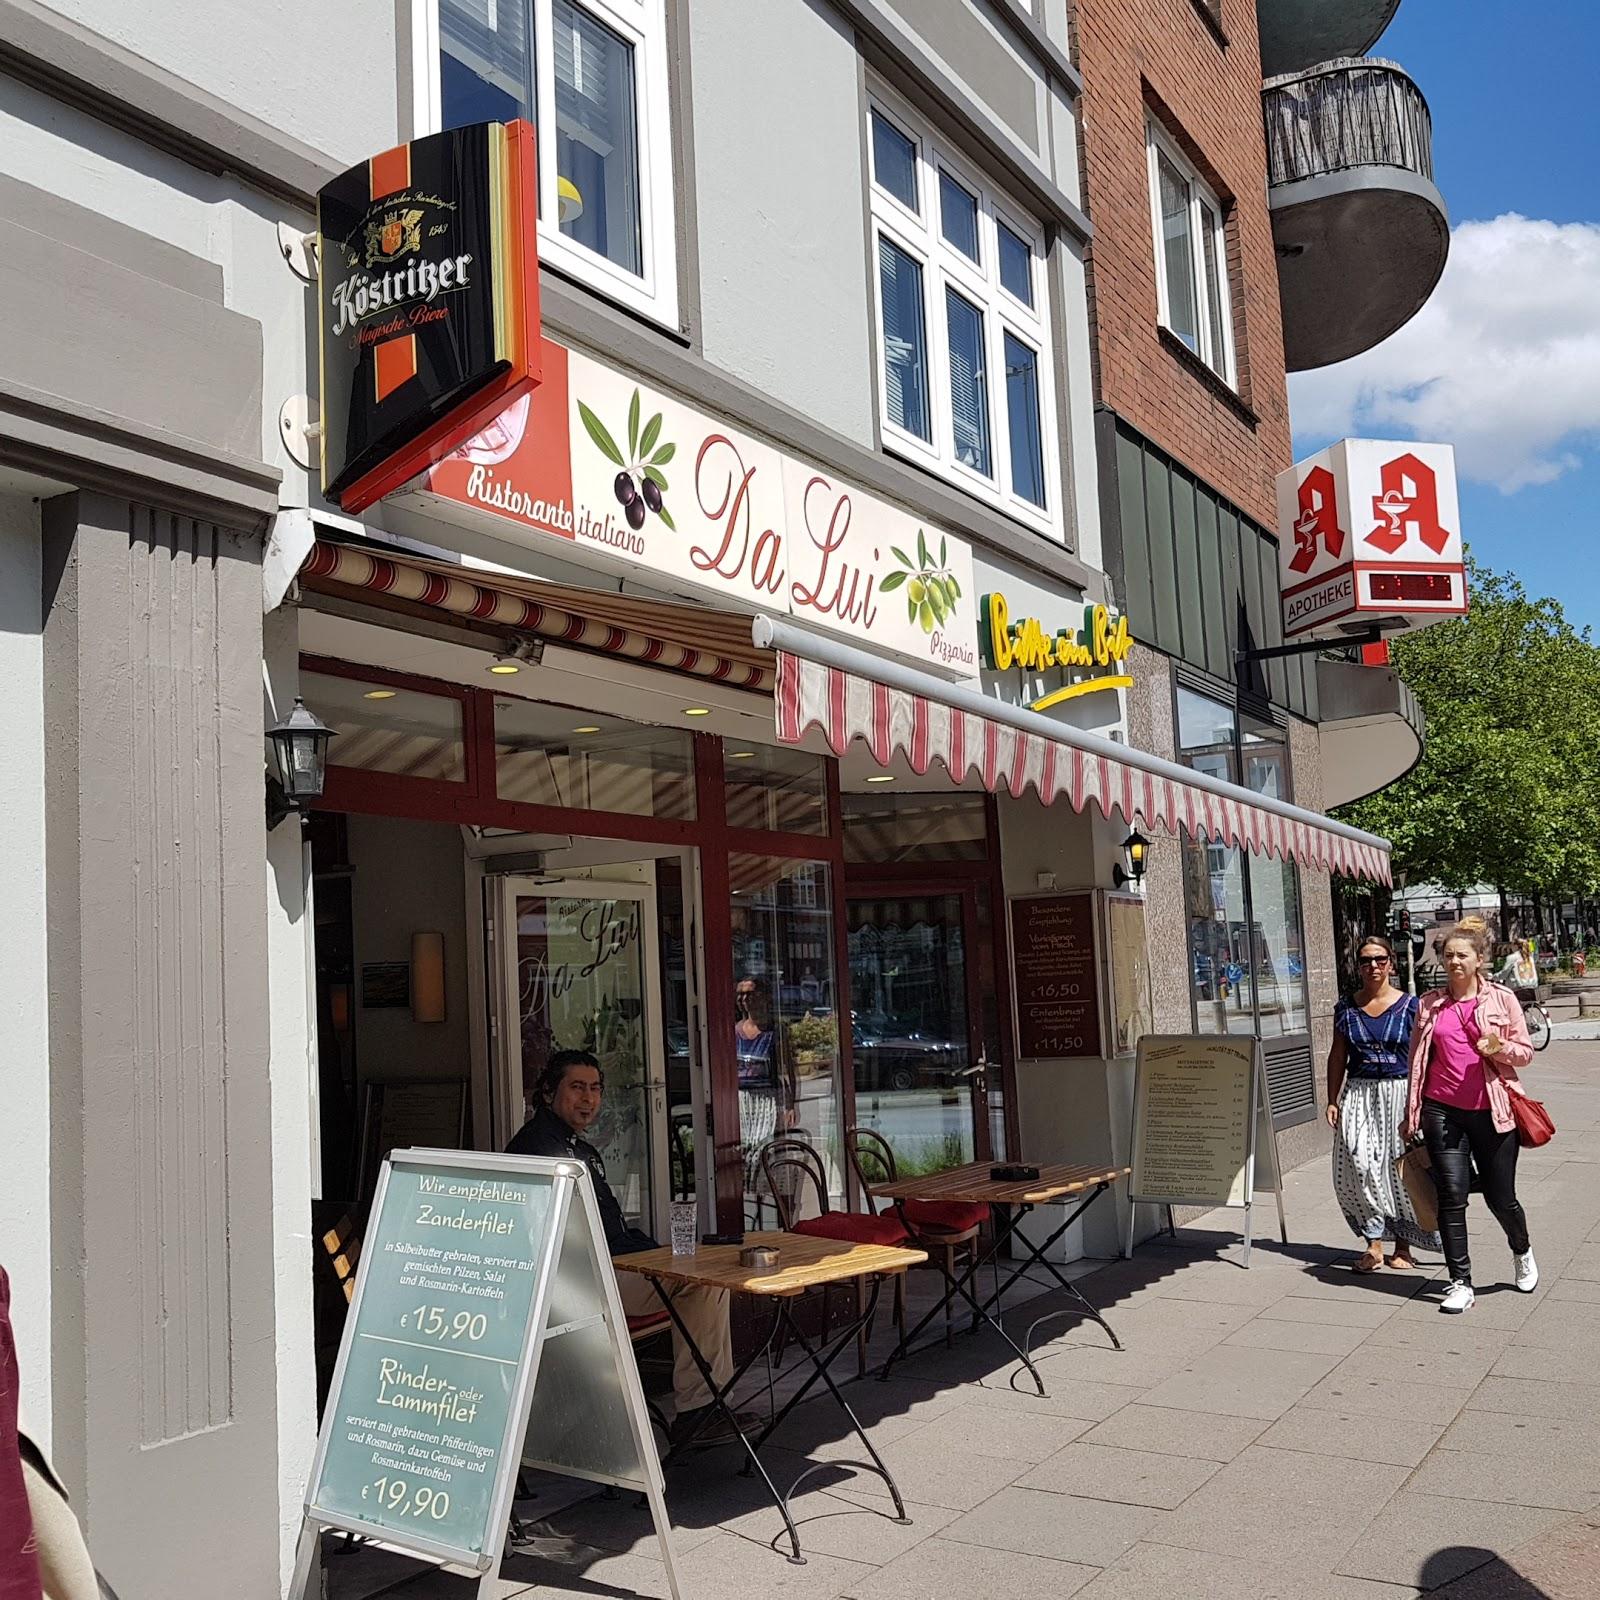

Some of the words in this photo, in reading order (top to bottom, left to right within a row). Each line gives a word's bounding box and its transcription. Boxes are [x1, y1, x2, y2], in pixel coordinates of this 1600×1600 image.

[428, 223, 449, 237] 1543
[349, 315, 405, 350] Magische
[406, 304, 449, 328] Biere
[467, 464, 575, 532] Ristorante
[577, 505, 645, 555] italiano
[689, 434, 785, 594] Da
[791, 477, 880, 629] Lui
[1288, 581, 1352, 620] APOTHEKE
[930, 630, 974, 665] Pizzaria
[1037, 984, 1080, 998] 16,50
[1041, 1036, 1083, 1051] 11,50
[418, 1175, 445, 1192] Wir
[449, 1180, 526, 1203] empfehlen:
[416, 1204, 515, 1239] Zanderfilet
[384, 1240, 394, 1252] in
[394, 1242, 443, 1259] Salbeibutter
[443, 1249, 481, 1265] gebraten,
[483, 1256, 517, 1269] serviert
[517, 1260, 535, 1271] mit
[403, 1260, 452, 1276] gemischten
[453, 1265, 481, 1281] Pilzen,
[483, 1270, 506, 1284] Salat
[400, 1275, 418, 1286] und
[413, 1304, 487, 1341] 15,90
[379, 1357, 457, 1392] Rinder-
[458, 1386, 484, 1401] oder
[377, 1380, 477, 1426] Lammfilet
[346, 1415, 377, 1431] serviert
[377, 1421, 393, 1433] mit
[391, 1425, 439, 1446] gebratenen
[347, 1432, 365, 1443] und
[365, 1433, 405, 1454] Rosmarin,
[407, 1444, 430, 1460] dazu
[431, 1450, 466, 1468] Gemüse
[467, 1461, 486, 1472] und
[371, 1452, 452, 1482] Rosmarinkartoffeln
[374, 1477, 450, 1520] 19,90
